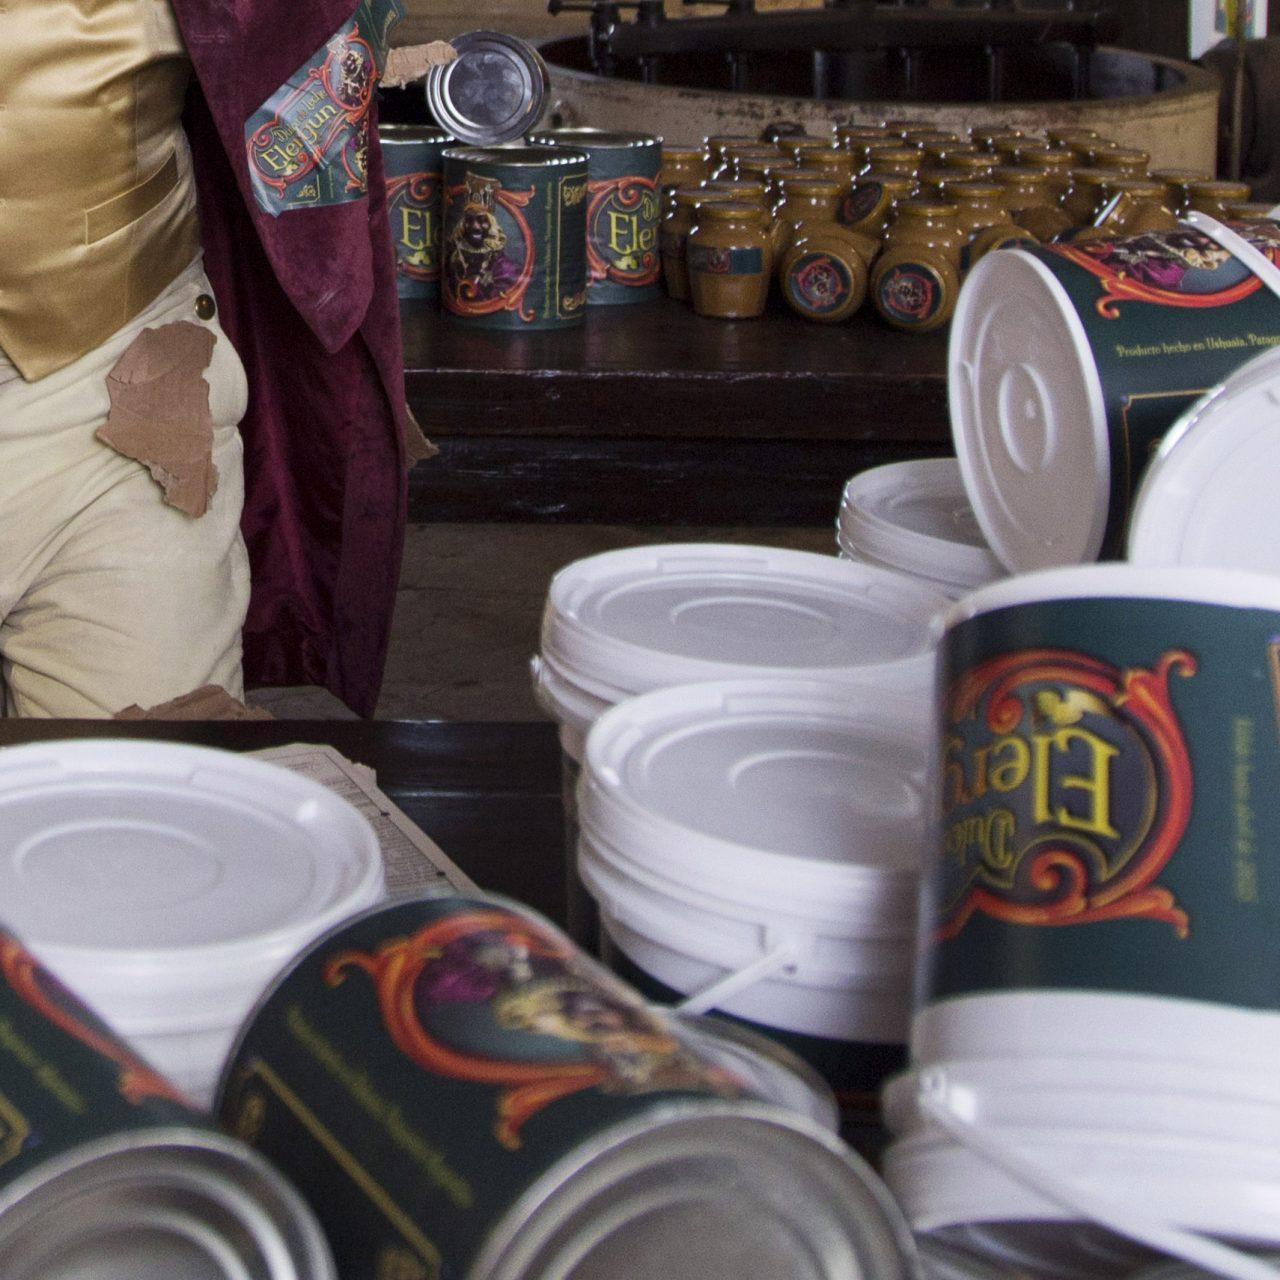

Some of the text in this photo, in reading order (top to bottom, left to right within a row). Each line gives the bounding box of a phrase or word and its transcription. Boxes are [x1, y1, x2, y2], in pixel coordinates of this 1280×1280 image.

[261, 104, 337, 170] Elergun
[1116, 343, 1161, 358] Producto
[1163, 340, 1192, 354] hecho
[1193, 342, 1205, 352] en
